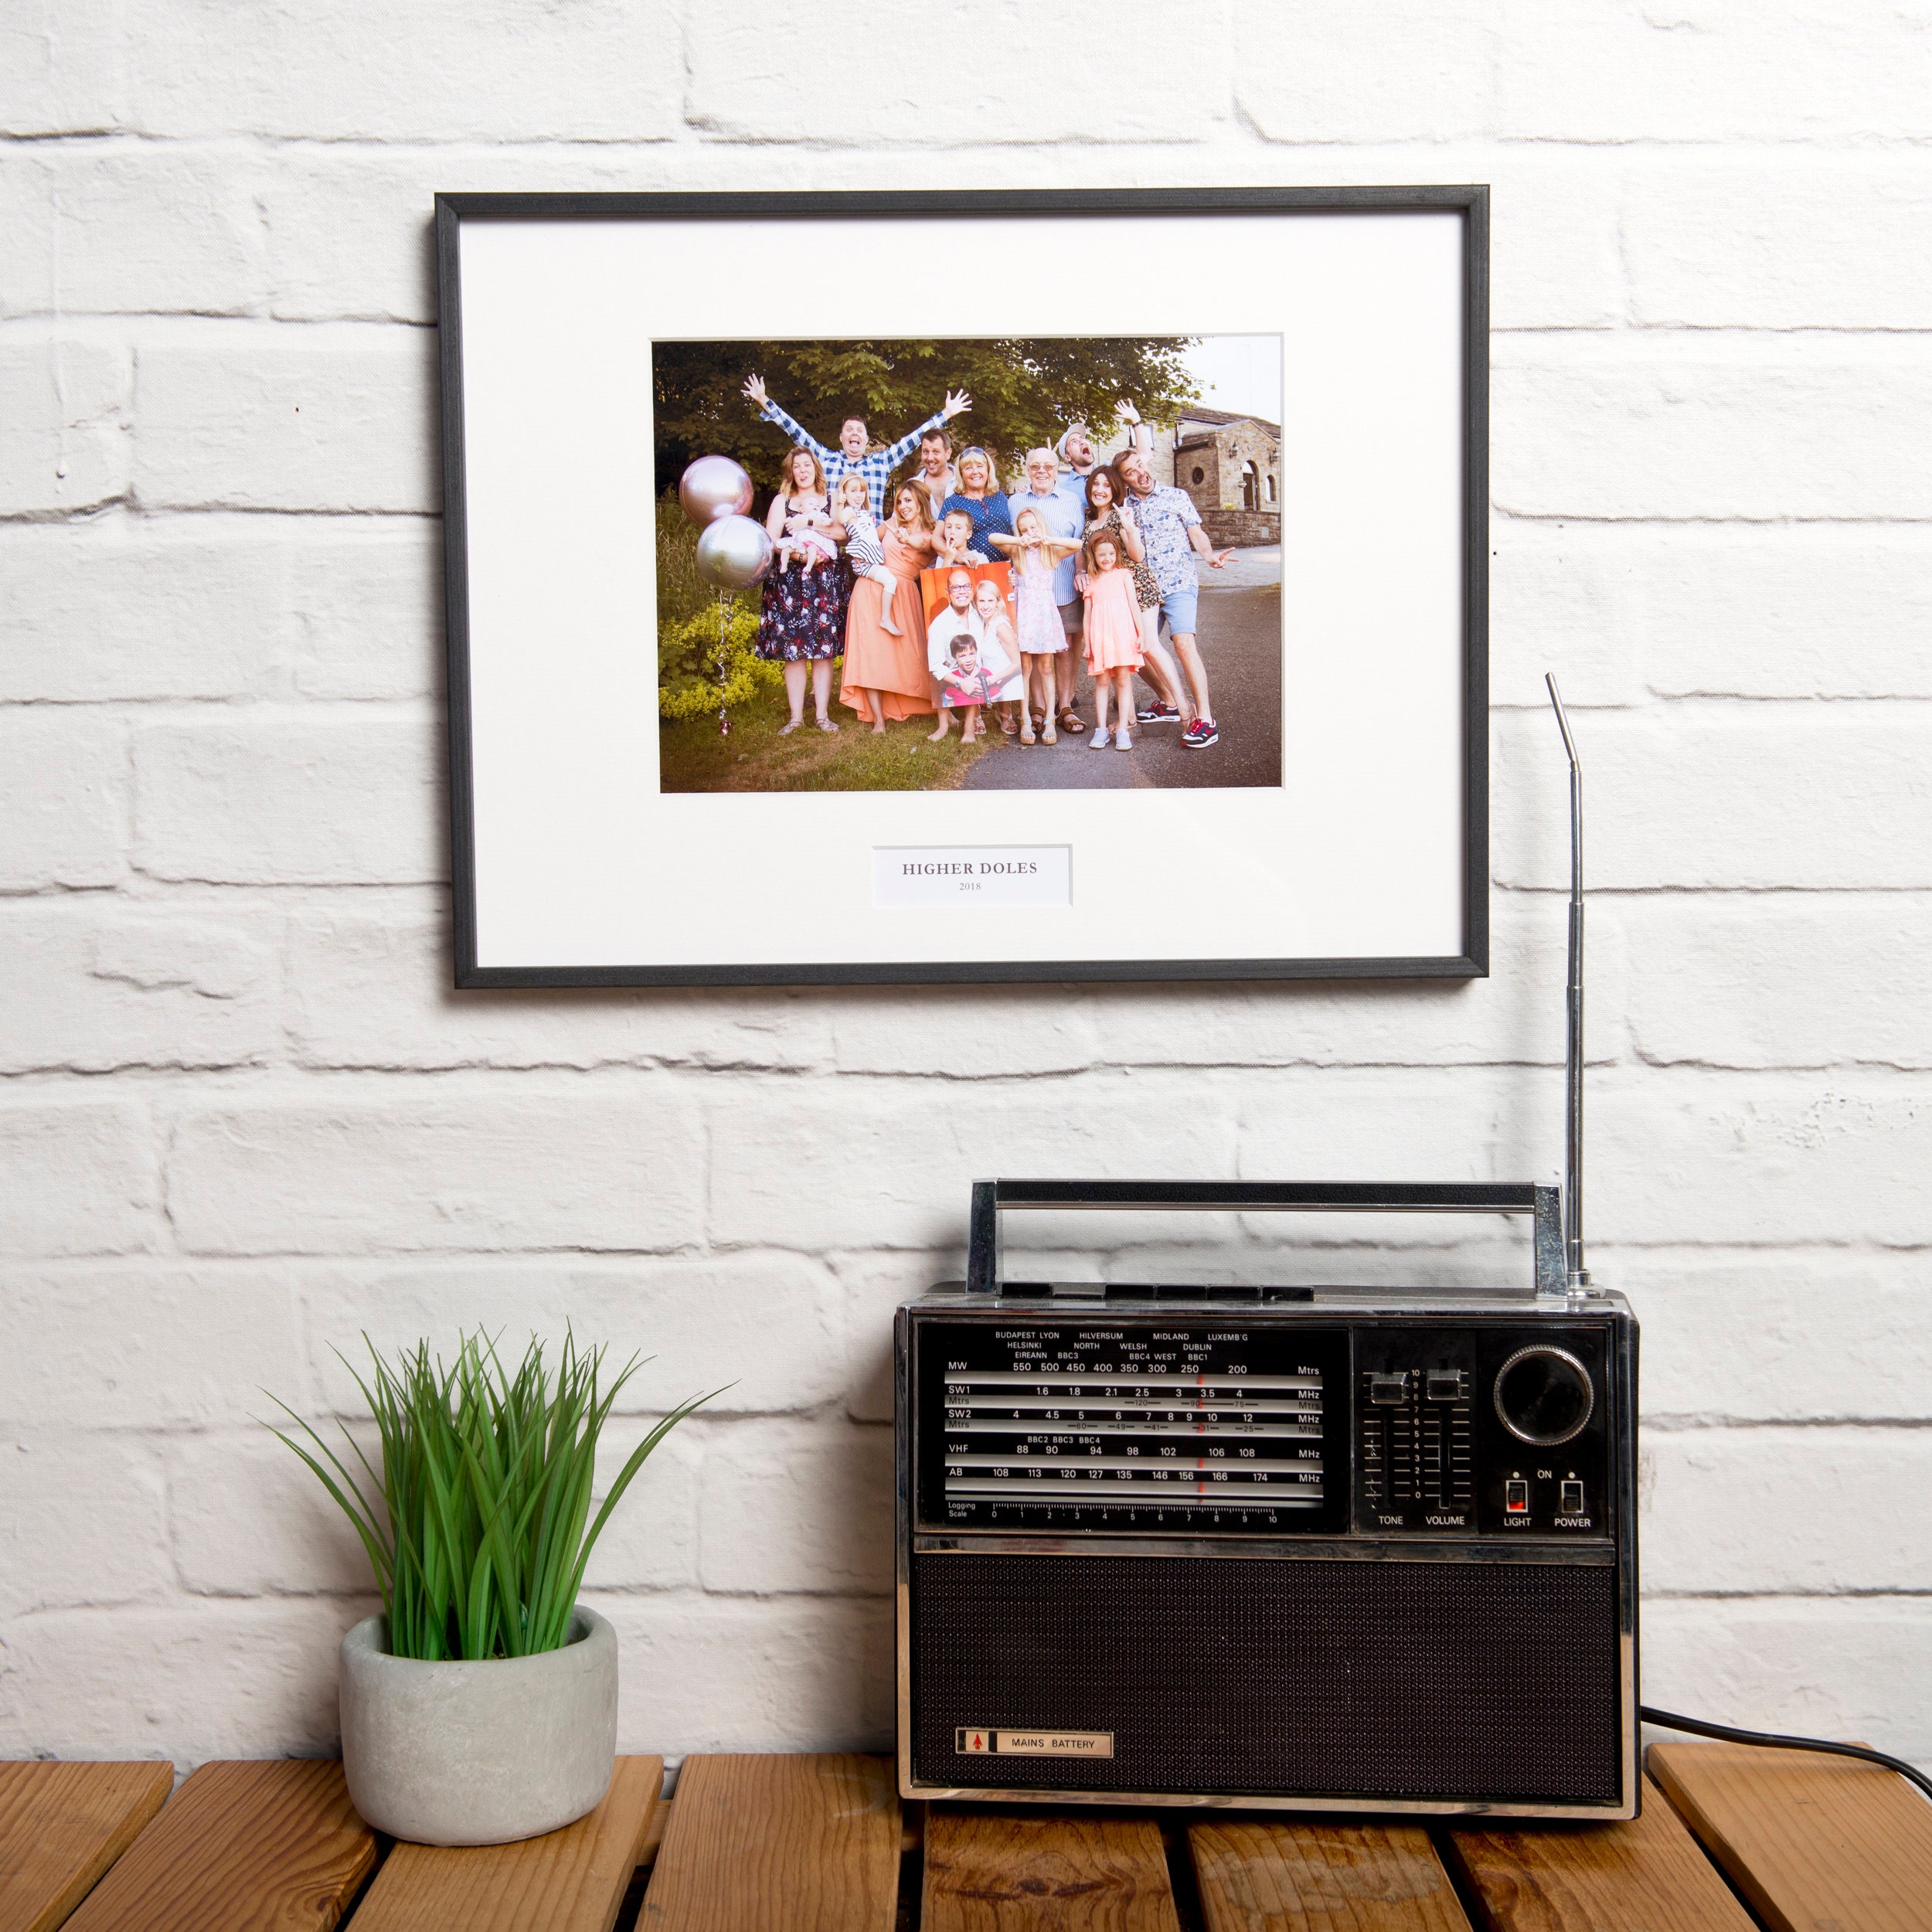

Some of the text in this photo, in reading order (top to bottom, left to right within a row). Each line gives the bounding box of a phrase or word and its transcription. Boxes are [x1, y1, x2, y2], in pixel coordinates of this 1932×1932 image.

[902, 862, 1038, 876] HIGHER DOLES
[959, 883, 981, 891] 2018
[948, 1362, 1320, 1375] MW 550 500 450 400 350 300 250 200 Mtrs
[948, 1386, 971, 1394] SW1
[1036, 1387, 1049, 1396] 1.6
[1070, 1387, 1080, 1396] 1.8
[1135, 1388, 1149, 1397] 2.5
[1175, 1389, 1182, 1397] 3
[1200, 1389, 1215, 1398] 3.5
[1298, 1391, 1320, 1400] MHz
[948, 1396, 970, 1405] Mtrs
[1298, 1401, 1320, 1410] Mtrs
[948, 1410, 971, 1418] SW2
[1013, 1410, 1019, 1419] 4
[1078, 1411, 1084, 1420] 5
[1115, 1411, 1121, 1420] 6
[1146, 1412, 1151, 1420] 7
[1168, 1413, 1174, 1421] 8
[1186, 1413, 1192, 1421] 9
[1207, 1413, 1218, 1422] 10
[1243, 1413, 1253, 1422] 12
[1298, 1415, 1320, 1423] MHz
[948, 1420, 970, 1429] Mtrs
[1298, 1426, 1320, 1434] Mtrs
[948, 1444, 1320, 1458] VHF 88 90 94 98 102 106 108 MHz
[949, 1468, 1320, 1483] AB 108 113 120 127 135 146 156 166 174 MHz
[1537, 1470, 1552, 1479] ON
[948, 1502, 975, 1510] Logging
[1378, 1516, 1465, 1525] TONE VOLUME
[1504, 1518, 1591, 1527] LIGHT POWER
[1012, 1738, 1095, 1749] MAINS BATTERY
